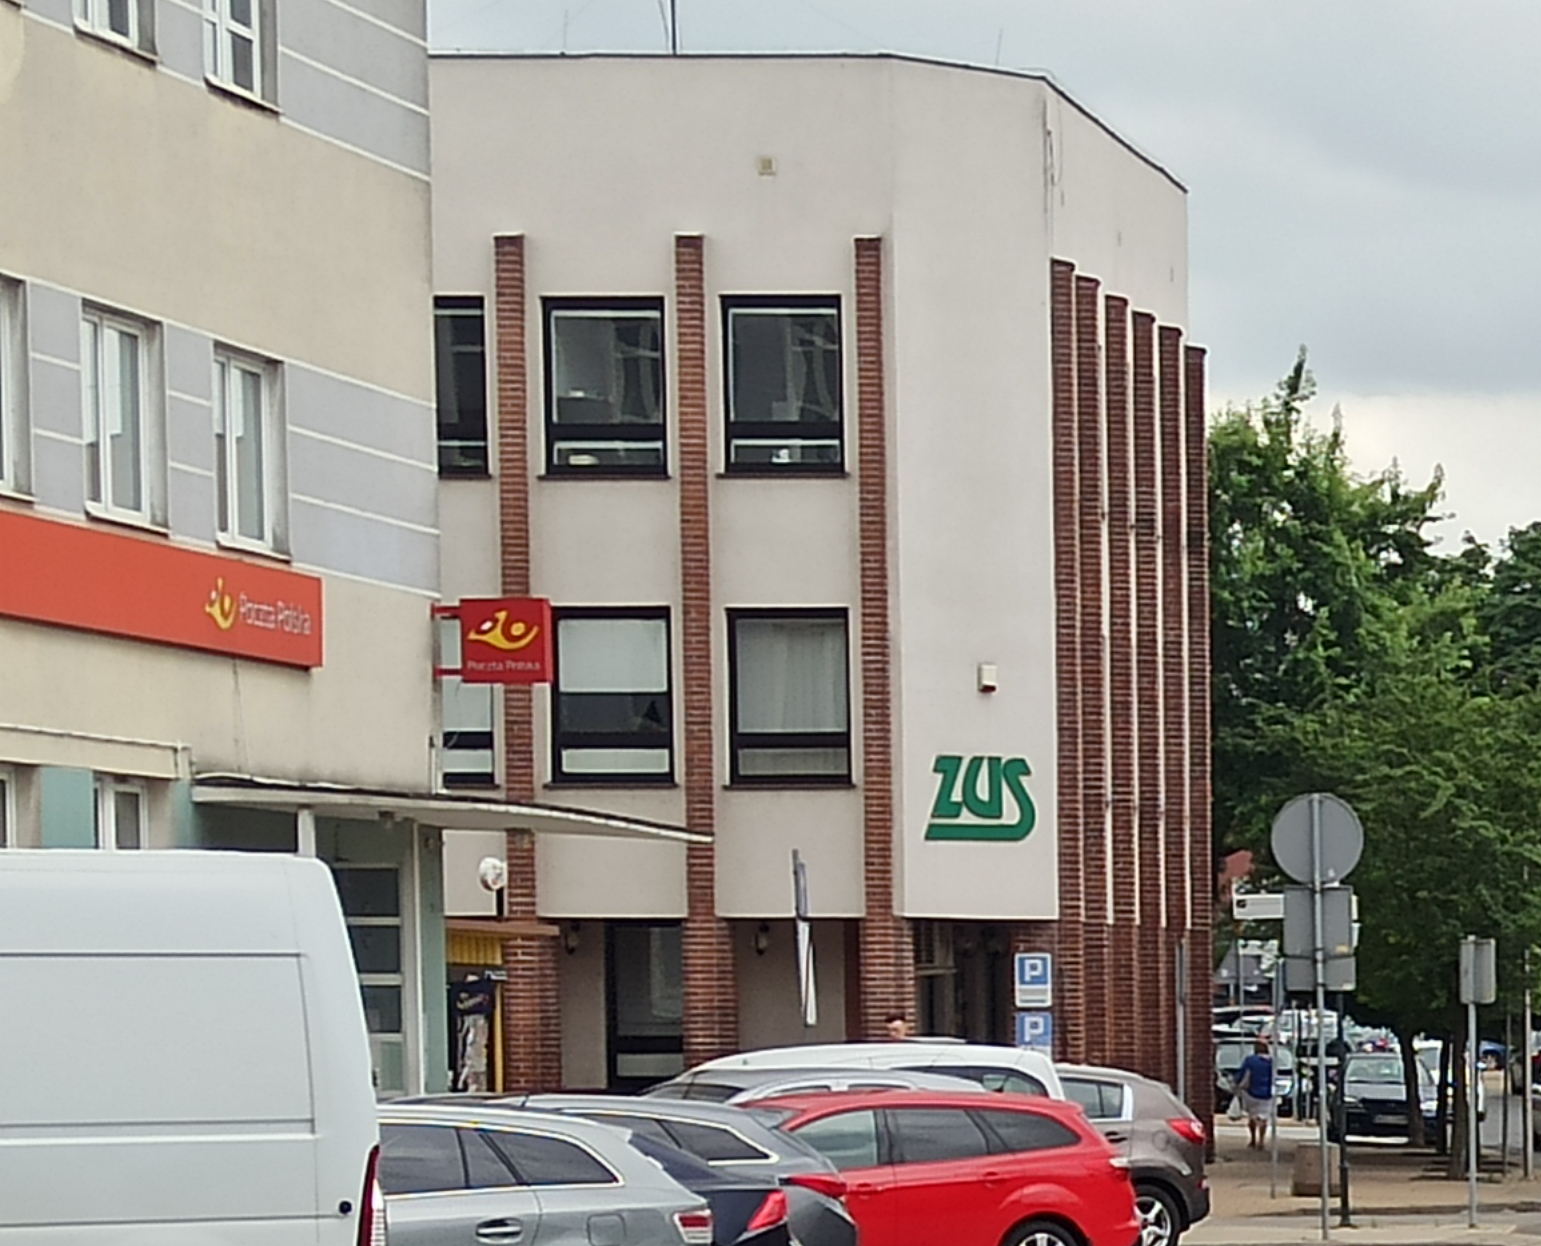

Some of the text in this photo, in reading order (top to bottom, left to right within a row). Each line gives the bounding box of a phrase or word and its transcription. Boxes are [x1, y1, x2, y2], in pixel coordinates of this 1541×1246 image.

[924, 755, 1036, 842] ZUS
[1023, 958, 1043, 983] P
[1023, 1015, 1044, 1042] P
